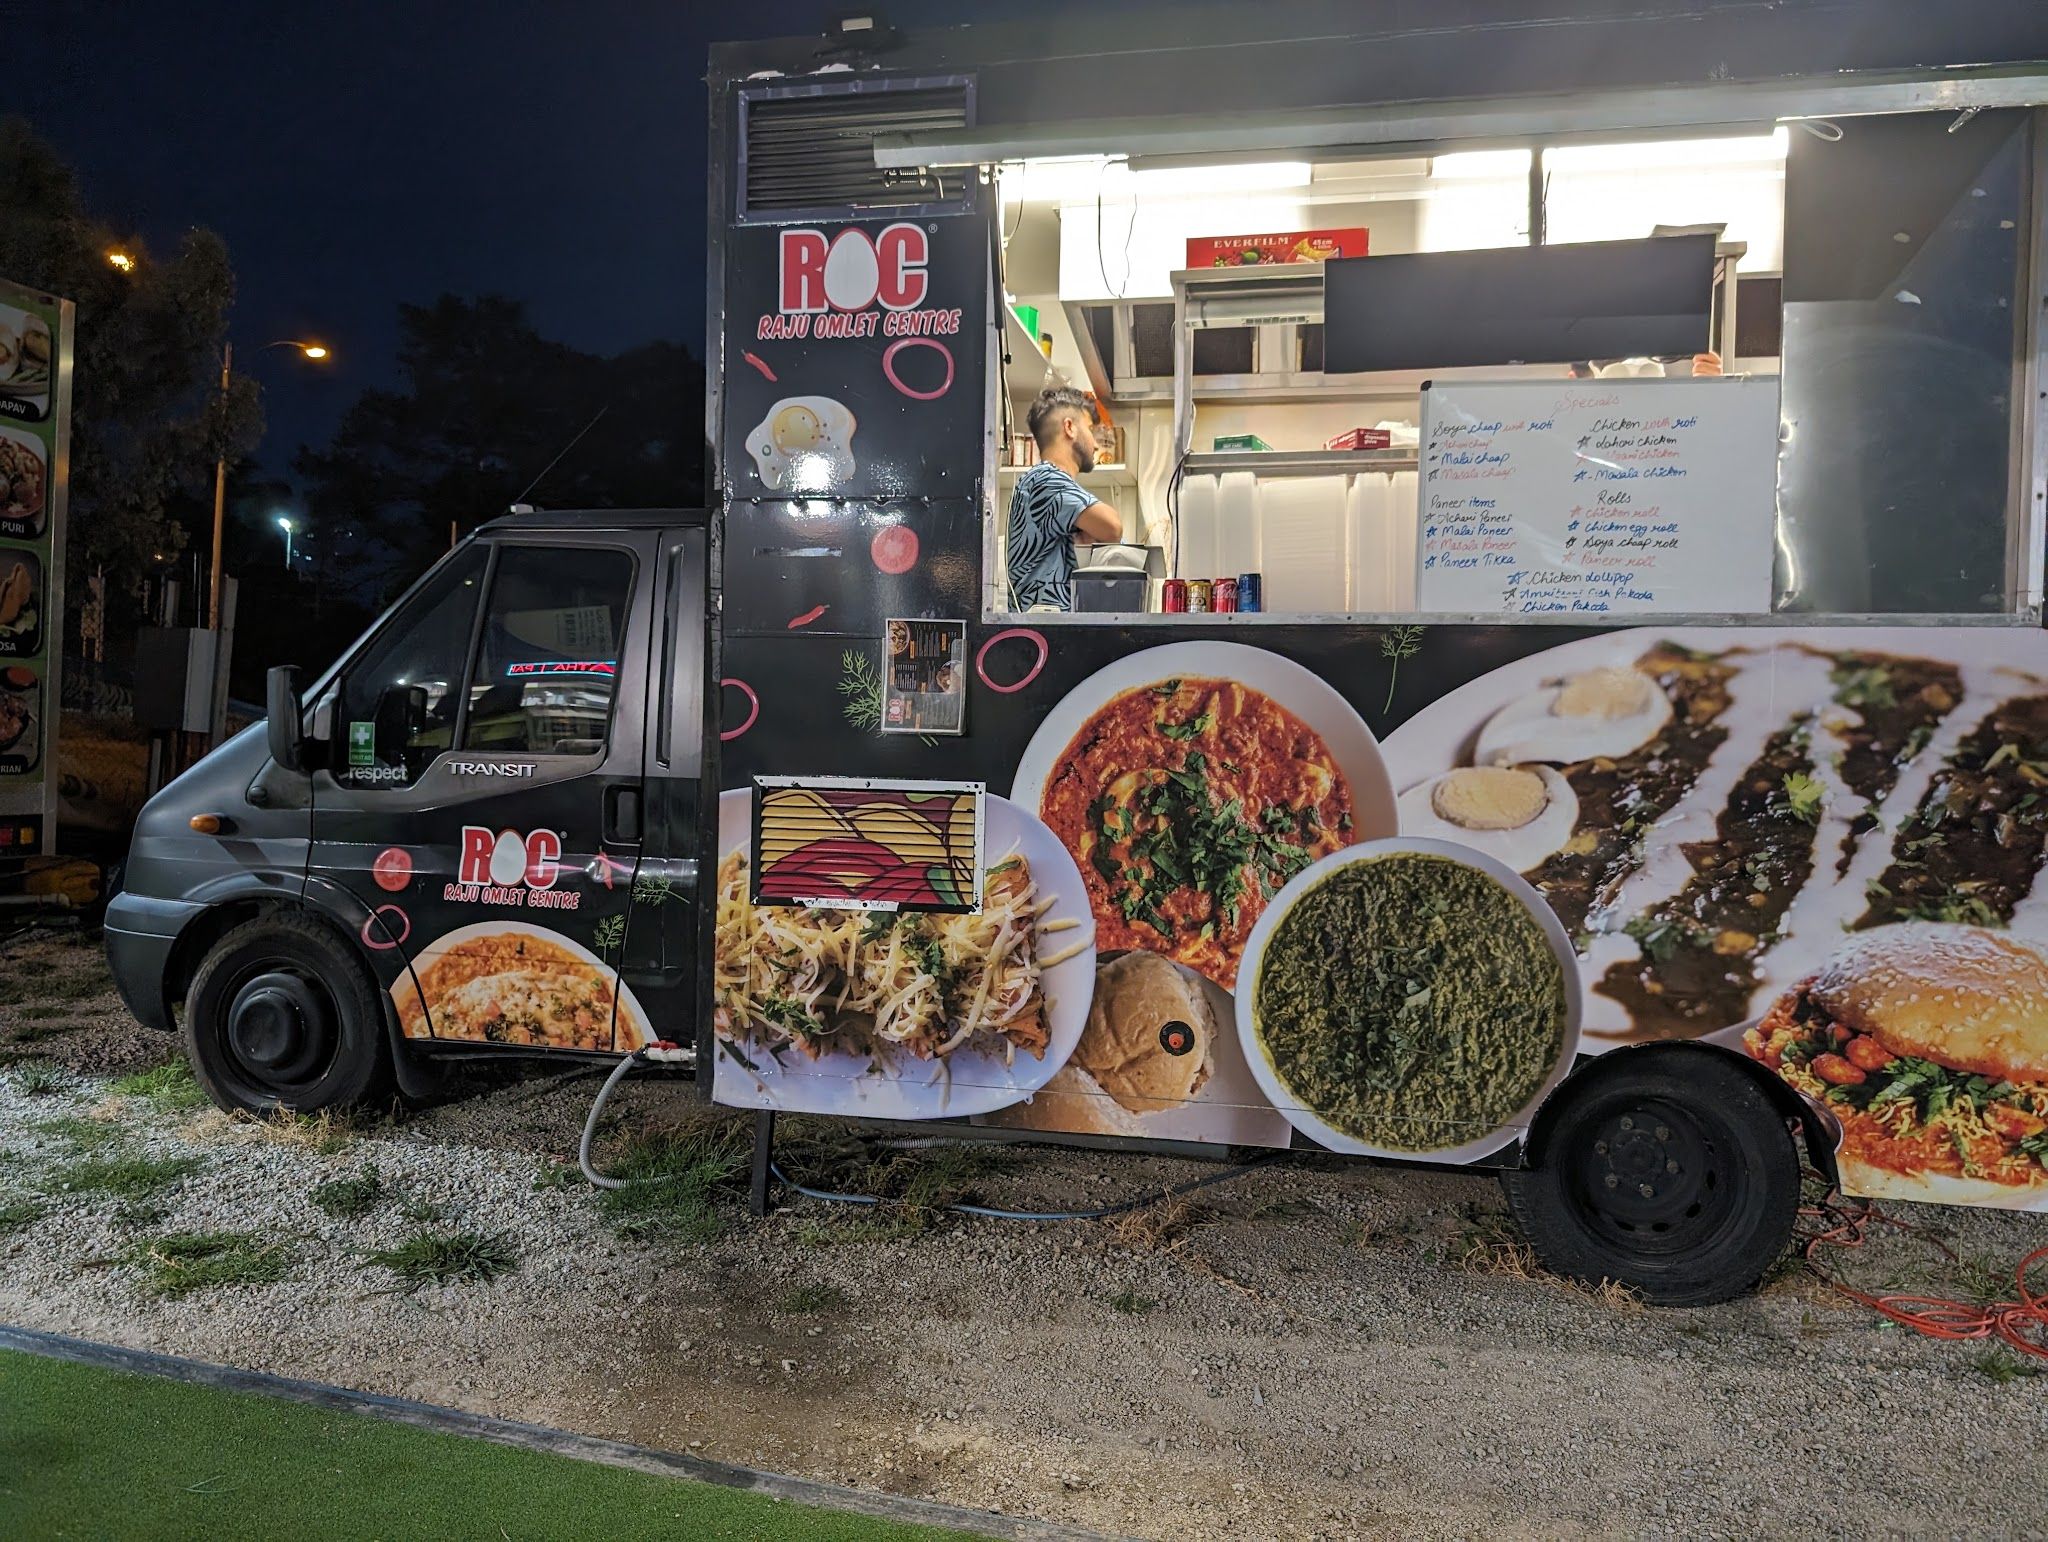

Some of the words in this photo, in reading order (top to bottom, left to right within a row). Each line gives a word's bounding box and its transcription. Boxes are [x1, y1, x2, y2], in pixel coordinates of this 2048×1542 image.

[1213, 236, 1290, 249] EVERFILM
[757, 314, 811, 340] RAJU
[813, 312, 880, 338] OMLET
[883, 309, 962, 336] CENTRE
[0, 401, 26, 414] APAV
[1589, 418, 1641, 433] Chicken
[1469, 496, 1496, 508] items
[1597, 489, 1632, 505] Rolls
[1480, 509, 1513, 523] Paneer
[2, 521, 25, 534] PURI
[1477, 523, 1513, 536] Paneer
[1629, 524, 1648, 537] egg
[1526, 570, 1582, 585] Chicken
[349, 763, 409, 783] respect
[448, 762, 537, 777] TRANSIT
[443, 883, 480, 902] RAJU
[481, 886, 527, 906] OMLET
[527, 890, 581, 910] CENTRE
